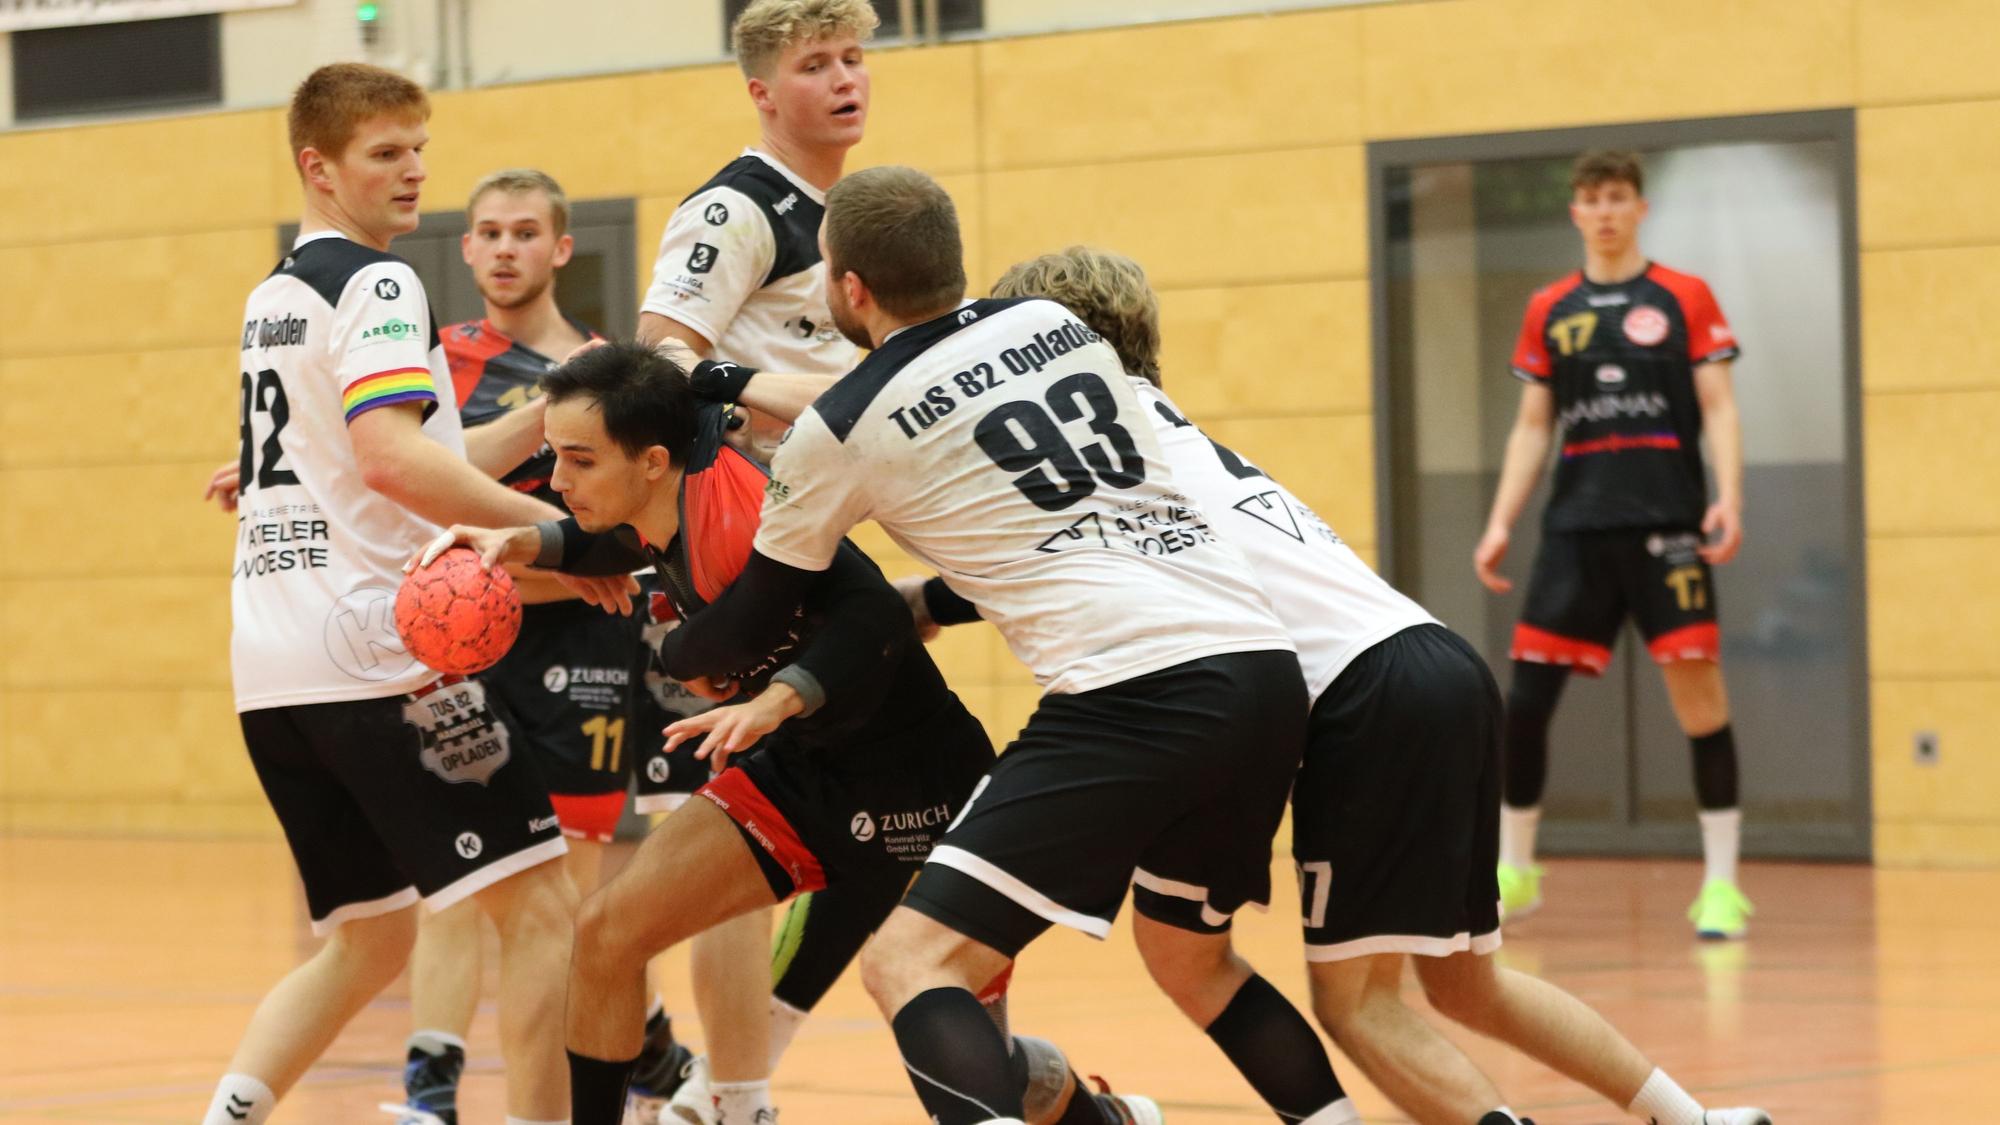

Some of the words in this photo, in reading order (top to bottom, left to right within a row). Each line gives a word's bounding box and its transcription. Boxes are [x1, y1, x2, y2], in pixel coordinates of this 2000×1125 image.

[1548, 312, 1598, 357] 17
[888, 385, 956, 440] TuS
[953, 362, 1005, 398] 82
[974, 372, 1145, 512] 93
[243, 547, 329, 580] VOESTE
[570, 668, 628, 685] ZURICH
[428, 699, 455, 717] TUS
[455, 691, 472, 709] 82
[441, 738, 502, 772] OPLADEN
[582, 717, 624, 773] 11
[880, 804, 950, 830] ZURICH
[745, 820, 776, 853] Kempa
[1294, 861, 1333, 928] 7
